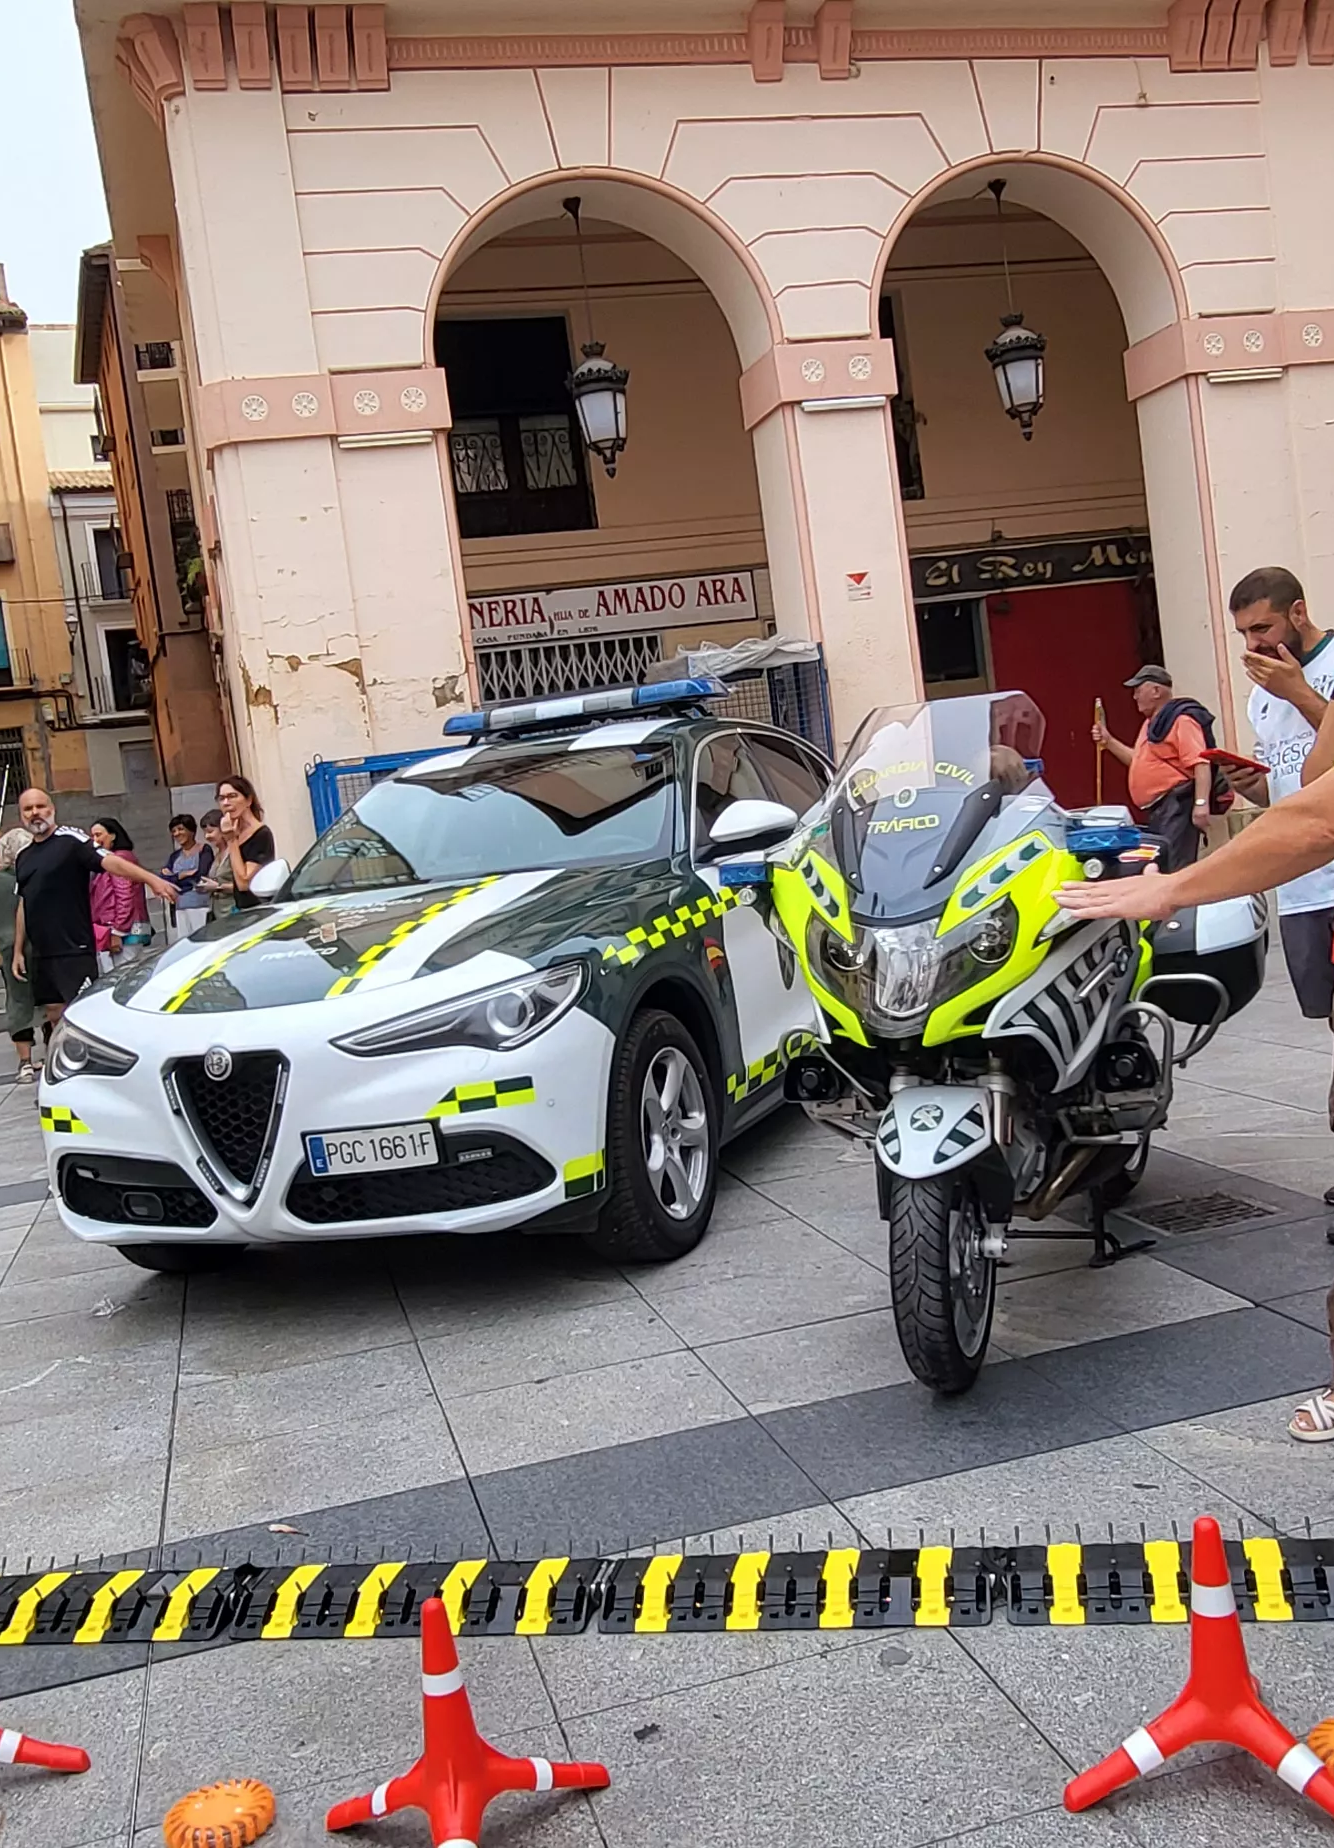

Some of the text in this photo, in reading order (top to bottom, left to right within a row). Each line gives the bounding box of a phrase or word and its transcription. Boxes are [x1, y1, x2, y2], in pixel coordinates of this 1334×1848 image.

[925, 559, 961, 586] El
[976, 555, 1053, 580] Rey
[578, 608, 590, 620] DE
[595, 583, 686, 617] AMADO
[695, 577, 748, 608] ARA
[476, 636, 499, 645] CASA
[852, 760, 976, 798] GUARDIA CIVIL
[867, 815, 940, 834] TRÁFICO
